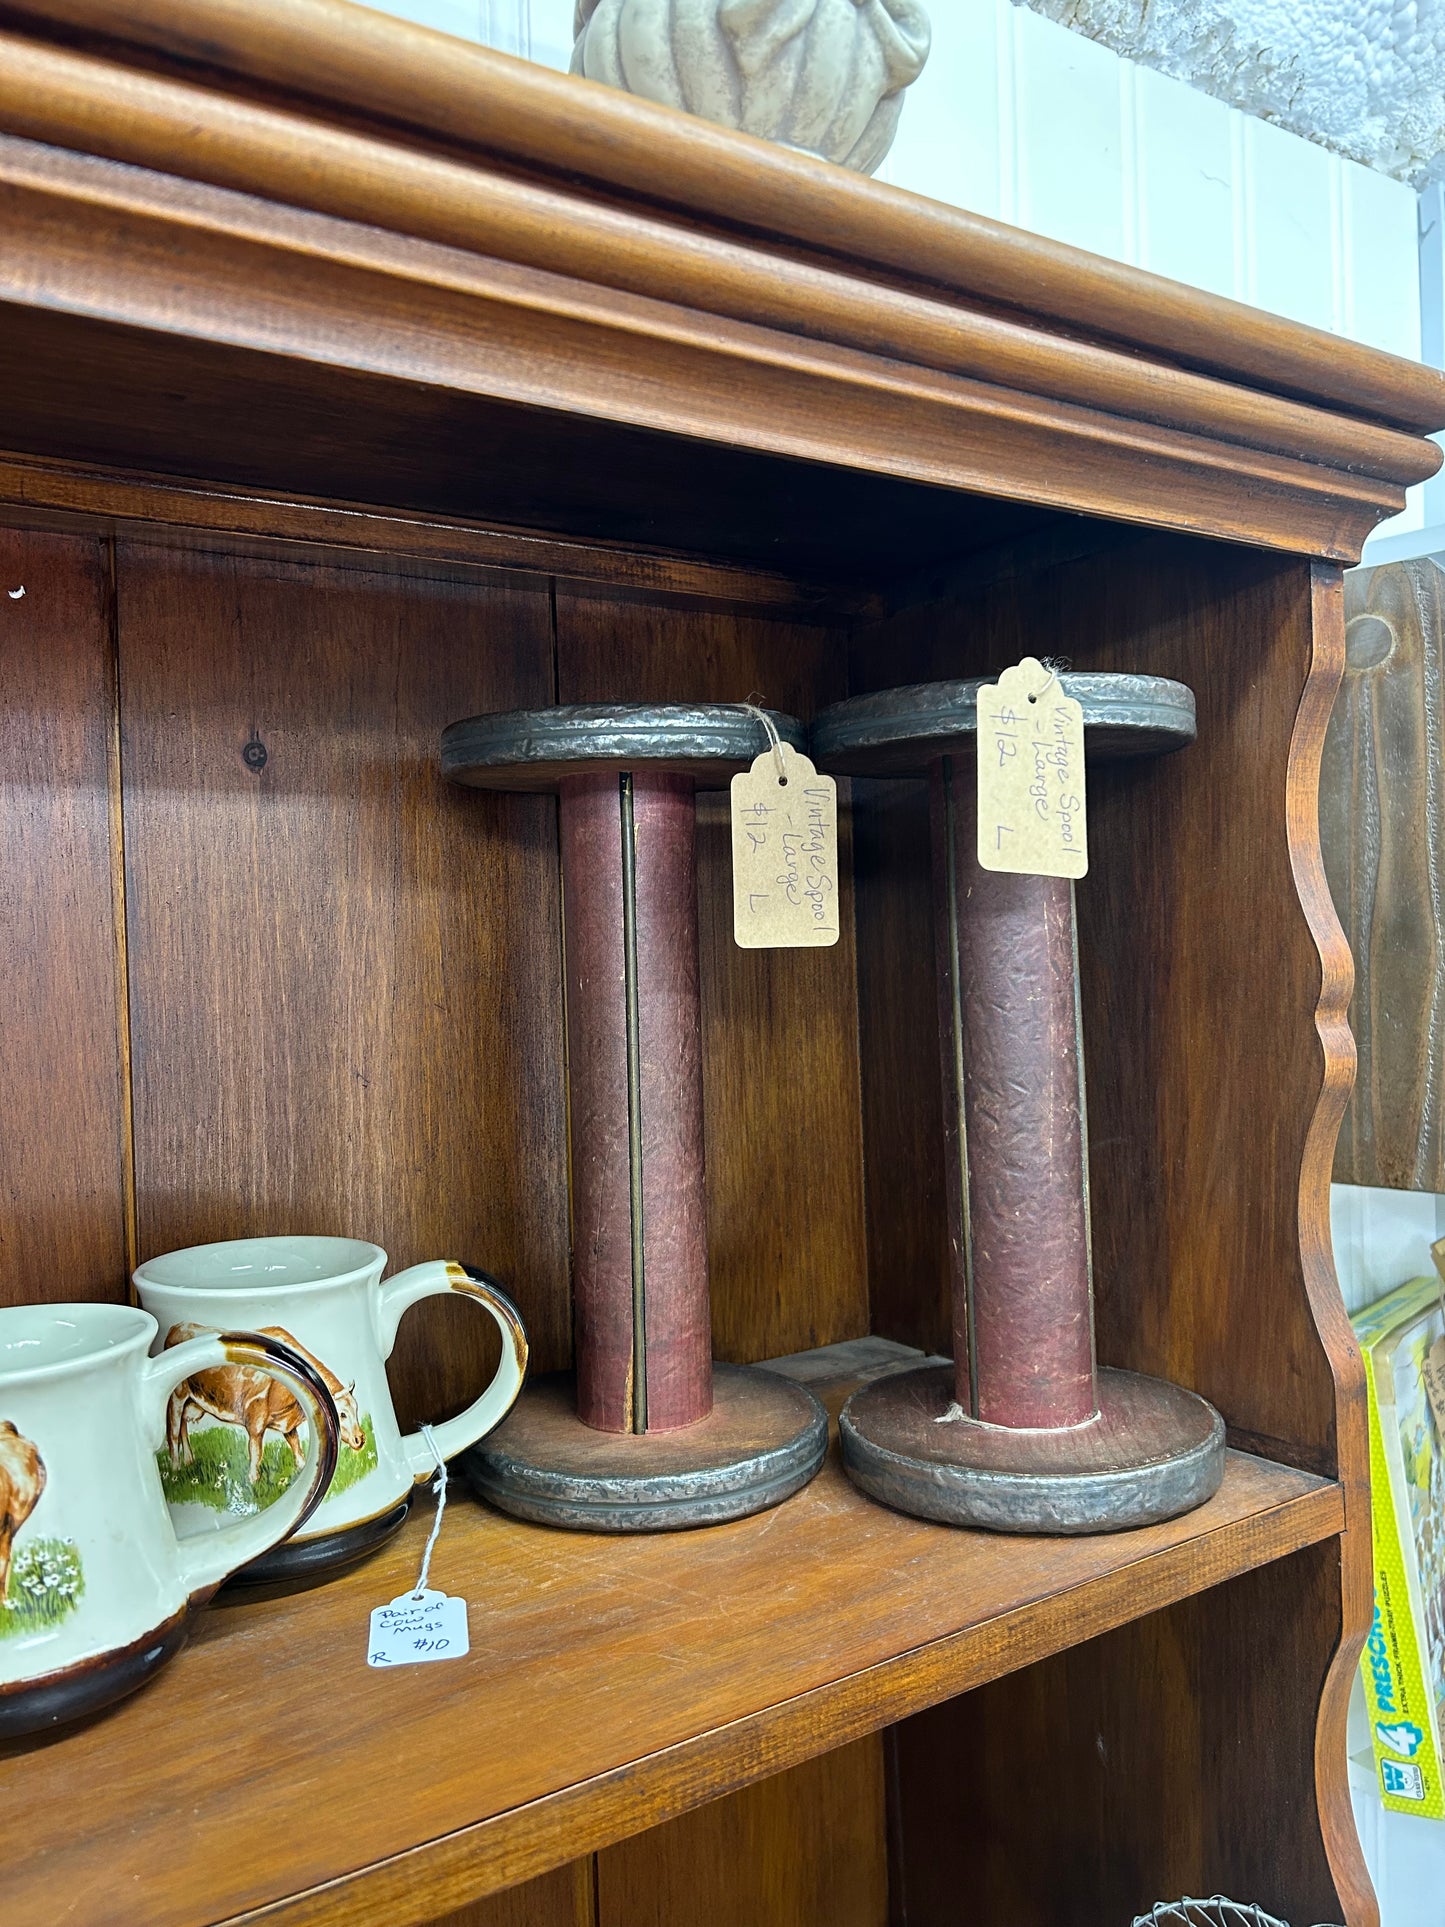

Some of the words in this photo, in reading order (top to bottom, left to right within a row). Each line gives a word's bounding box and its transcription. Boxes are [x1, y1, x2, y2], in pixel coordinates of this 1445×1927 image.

[989, 705, 1028, 767] $12
[1046, 706, 1075, 784] Vintage
[1029, 740, 1055, 822] Large
[740, 802, 777, 854] $12
[801, 788, 831, 873] Vintage
[996, 825, 1015, 850] L
[1055, 792, 1082, 854] Spool
[776, 833, 804, 906] Large
[749, 894, 770, 914] L
[804, 875, 837, 932] Spool
[377, 1609, 421, 1619] Pair
[369, 1651, 392, 1664] R
[1367, 1587, 1397, 1713] PRESCH
[1395, 1662, 1404, 1686] THICK
[1400, 1687, 1409, 1714] EXTRA
[1376, 1721, 1423, 1757] 4
